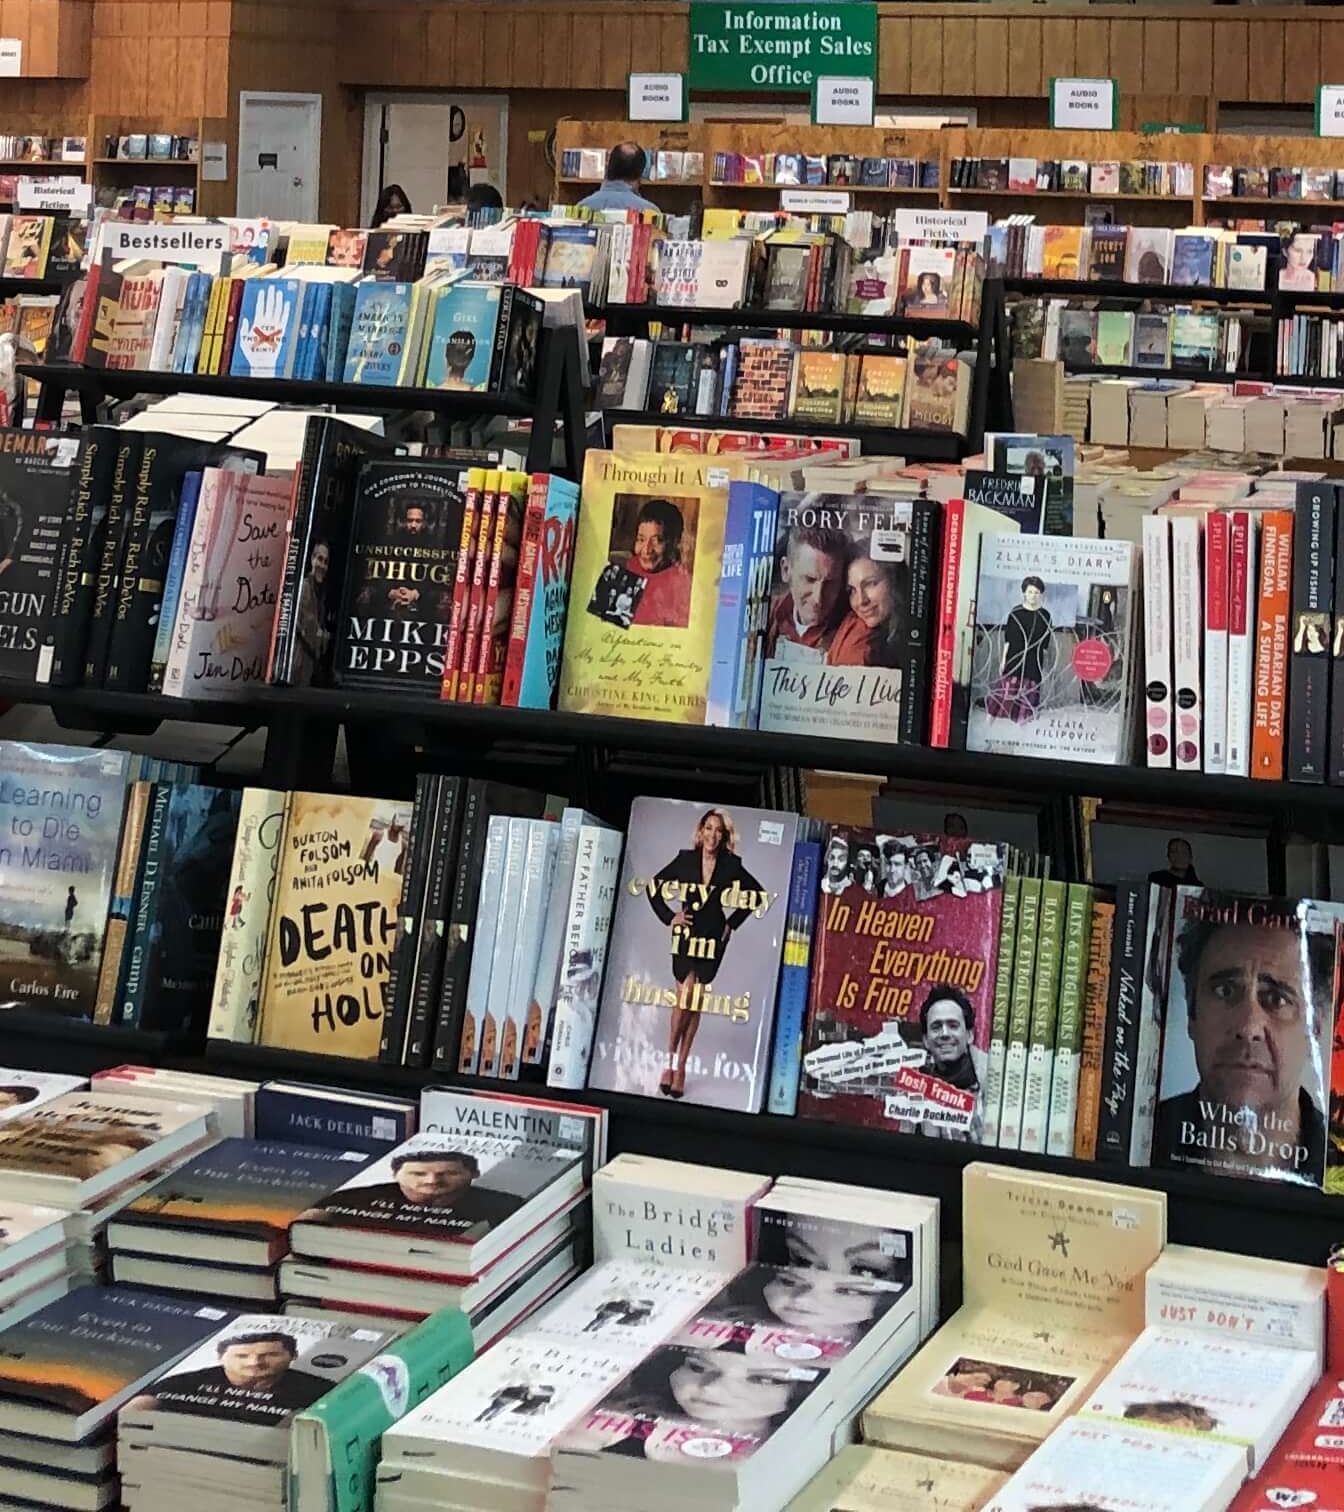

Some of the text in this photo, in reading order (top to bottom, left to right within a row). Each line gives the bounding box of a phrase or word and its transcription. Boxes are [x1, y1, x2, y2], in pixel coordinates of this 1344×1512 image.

[724, 10, 842, 31] Information
[693, 34, 873, 58] Tax Exempt Sales
[643, 83, 669, 91] AUDIO
[750, 64, 813, 85] Office
[832, 87, 859, 95] AUDIO
[641, 94, 670, 102] BOOKS
[831, 98, 860, 106] BOOKS
[1068, 101, 1099, 109] BOOKS
[1070, 90, 1098, 98] AUDIO
[915, 215, 967, 228] Historical
[922, 228, 959, 239] Fiction
[119, 232, 223, 249] Bestsellers
[967, 489, 1037, 510] BACKMAN
[237, 512, 280, 543] Save
[1262, 525, 1277, 599] FINNEGAN
[1275, 533, 1292, 593] WILLIAM
[1308, 495, 1321, 609] GROWING UP FISHER
[368, 559, 450, 585] THUG
[231, 575, 277, 615] Date
[935, 512, 959, 702] DEBORAH FELDMAN Exodus
[346, 615, 451, 649] MIKE
[348, 645, 447, 677] EPPS
[1254, 620, 1272, 729] A SURFING LIFE
[1268, 614, 1286, 738] BARBARIAN DAYS
[1048, 719, 1085, 730] ZLATA
[11, 814, 81, 842] to Die
[292, 828, 339, 848] BURTON
[21, 846, 93, 875] Miami
[299, 839, 352, 865] FOLSOM
[291, 859, 380, 892] ANITA FOLSOM
[628, 878, 770, 919] every day
[1002, 893, 1015, 929] HATS
[1022, 895, 1035, 930] HATS
[1043, 897, 1056, 932] HATS
[278, 900, 397, 968] DEATH
[827, 896, 935, 943] In Heaven
[1070, 901, 1084, 936] HATS
[670, 924, 716, 959] i'm
[360, 950, 393, 979] ON
[869, 940, 985, 993] Everything
[623, 973, 750, 1024] hustling
[835, 973, 913, 1017] Is Fine
[993, 948, 1010, 1032] EYEGLASSES
[1013, 949, 1031, 1034] EYEGLASSES
[1034, 952, 1051, 1037] EYEGLASSES
[1060, 955, 1078, 1040] EYEGLASSES
[898, 1070, 967, 1108] Josh Frank
[455, 1105, 553, 1136] VALENTIN
[887, 1102, 969, 1125] Charlie Buckholtz
[1197, 1099, 1293, 1133] When the
[1180, 1119, 1309, 1169] Balls Drop
[325, 1205, 474, 1229] CHANGE MY NAME
[370, 1197, 454, 1215] I'LL NEVER
[608, 1200, 736, 1238] The Bridge
[625, 1228, 718, 1262] Ladies
[985, 1250, 1026, 1275] God
[1027, 1255, 1068, 1284] Gave
[1071, 1258, 1099, 1286] Me
[1100, 1265, 1136, 1294] You
[1158, 1305, 1257, 1331] JUST DON'T
[156, 1390, 293, 1417] CHANGE MY NAME
[197, 1381, 275, 1402] I'LL NEVER
